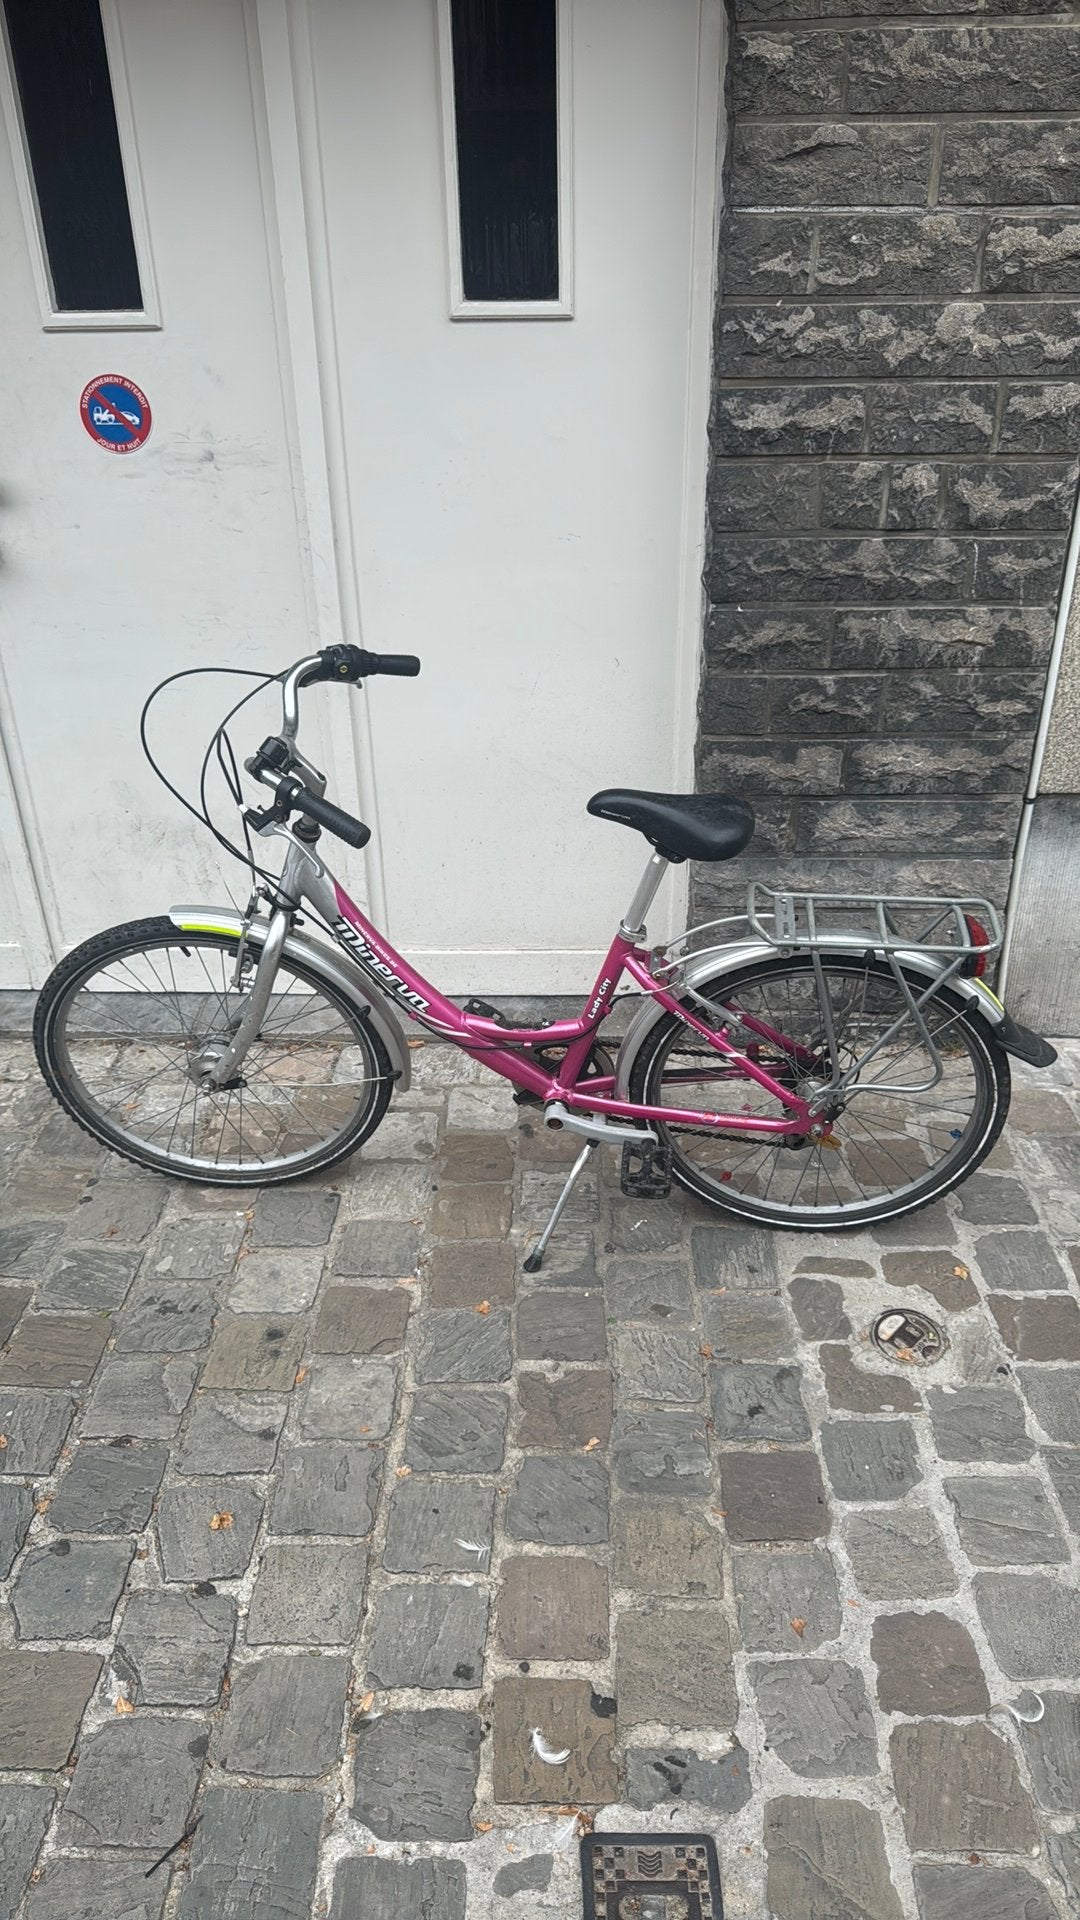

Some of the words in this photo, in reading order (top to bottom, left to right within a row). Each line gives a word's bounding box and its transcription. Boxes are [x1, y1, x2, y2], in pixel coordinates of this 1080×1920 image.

[82, 376, 123, 408] STATIONNEMENT
[123, 380, 148, 408] INTERDIT
[97, 437, 116, 450] JOUR
[126, 437, 141, 450] NUIT
[588, 997, 603, 1019] Lady
[599, 978, 612, 995] City
